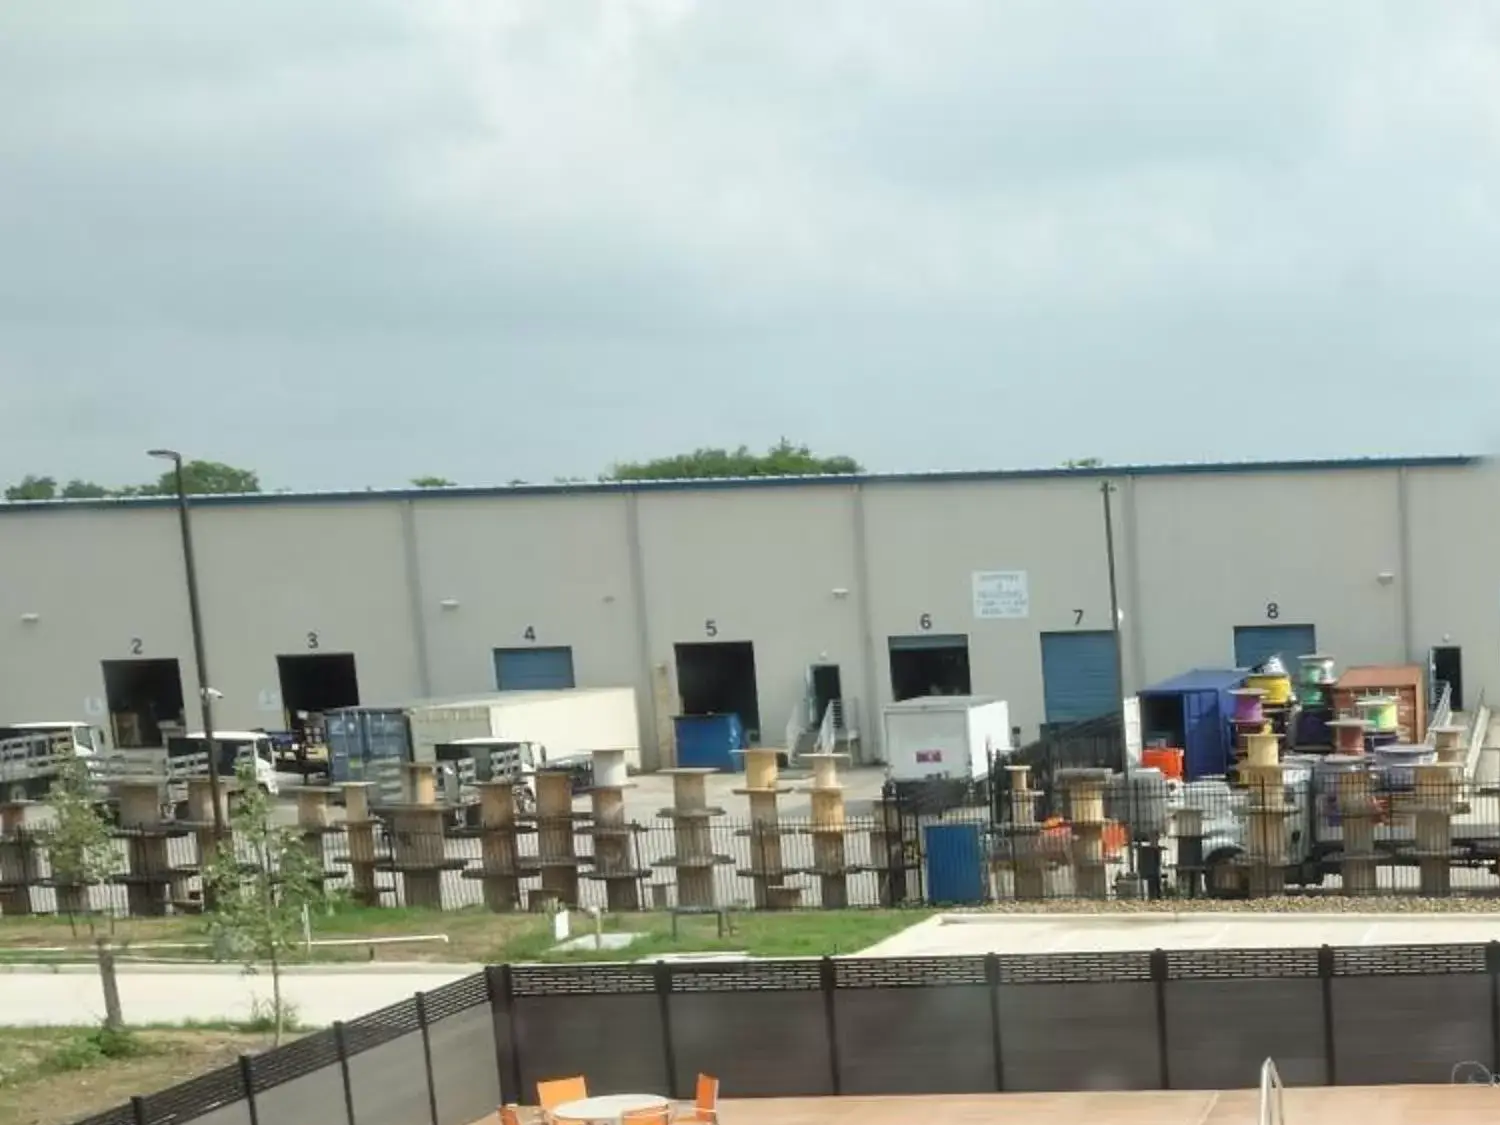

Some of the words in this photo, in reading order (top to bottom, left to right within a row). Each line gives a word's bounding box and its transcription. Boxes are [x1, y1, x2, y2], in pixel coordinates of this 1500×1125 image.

[1072, 608, 1084, 625] 7
[1266, 602, 1279, 619] 8
[705, 620, 718, 637] 5
[920, 613, 932, 630] 6
[307, 632, 319, 649] 3
[524, 625, 536, 641] 4
[130, 637, 143, 655] 2
